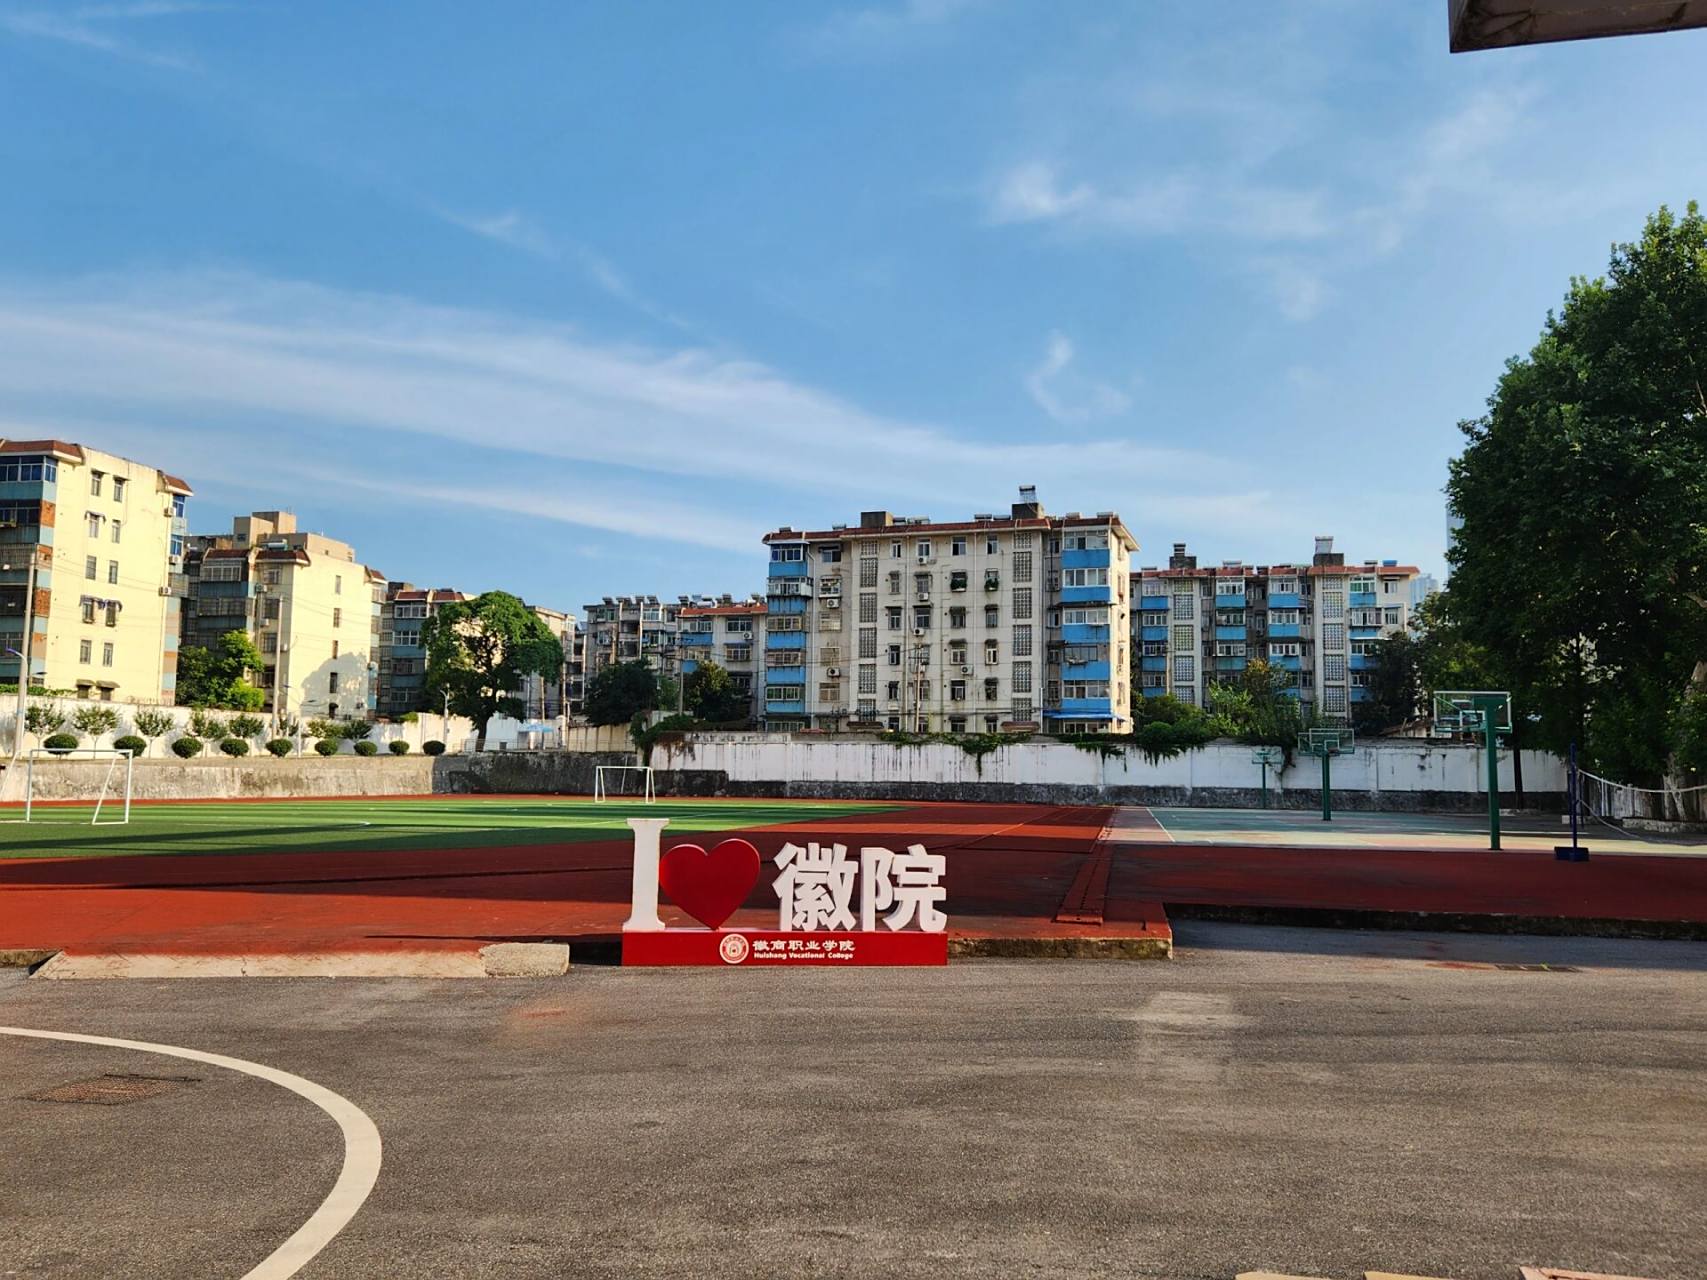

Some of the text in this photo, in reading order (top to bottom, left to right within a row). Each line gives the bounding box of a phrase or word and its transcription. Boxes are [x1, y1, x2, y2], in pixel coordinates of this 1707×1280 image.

[622, 818, 947, 932] I 徽院
[752, 940, 855, 951] 徽商职业学院
[828, 952, 853, 960] College
